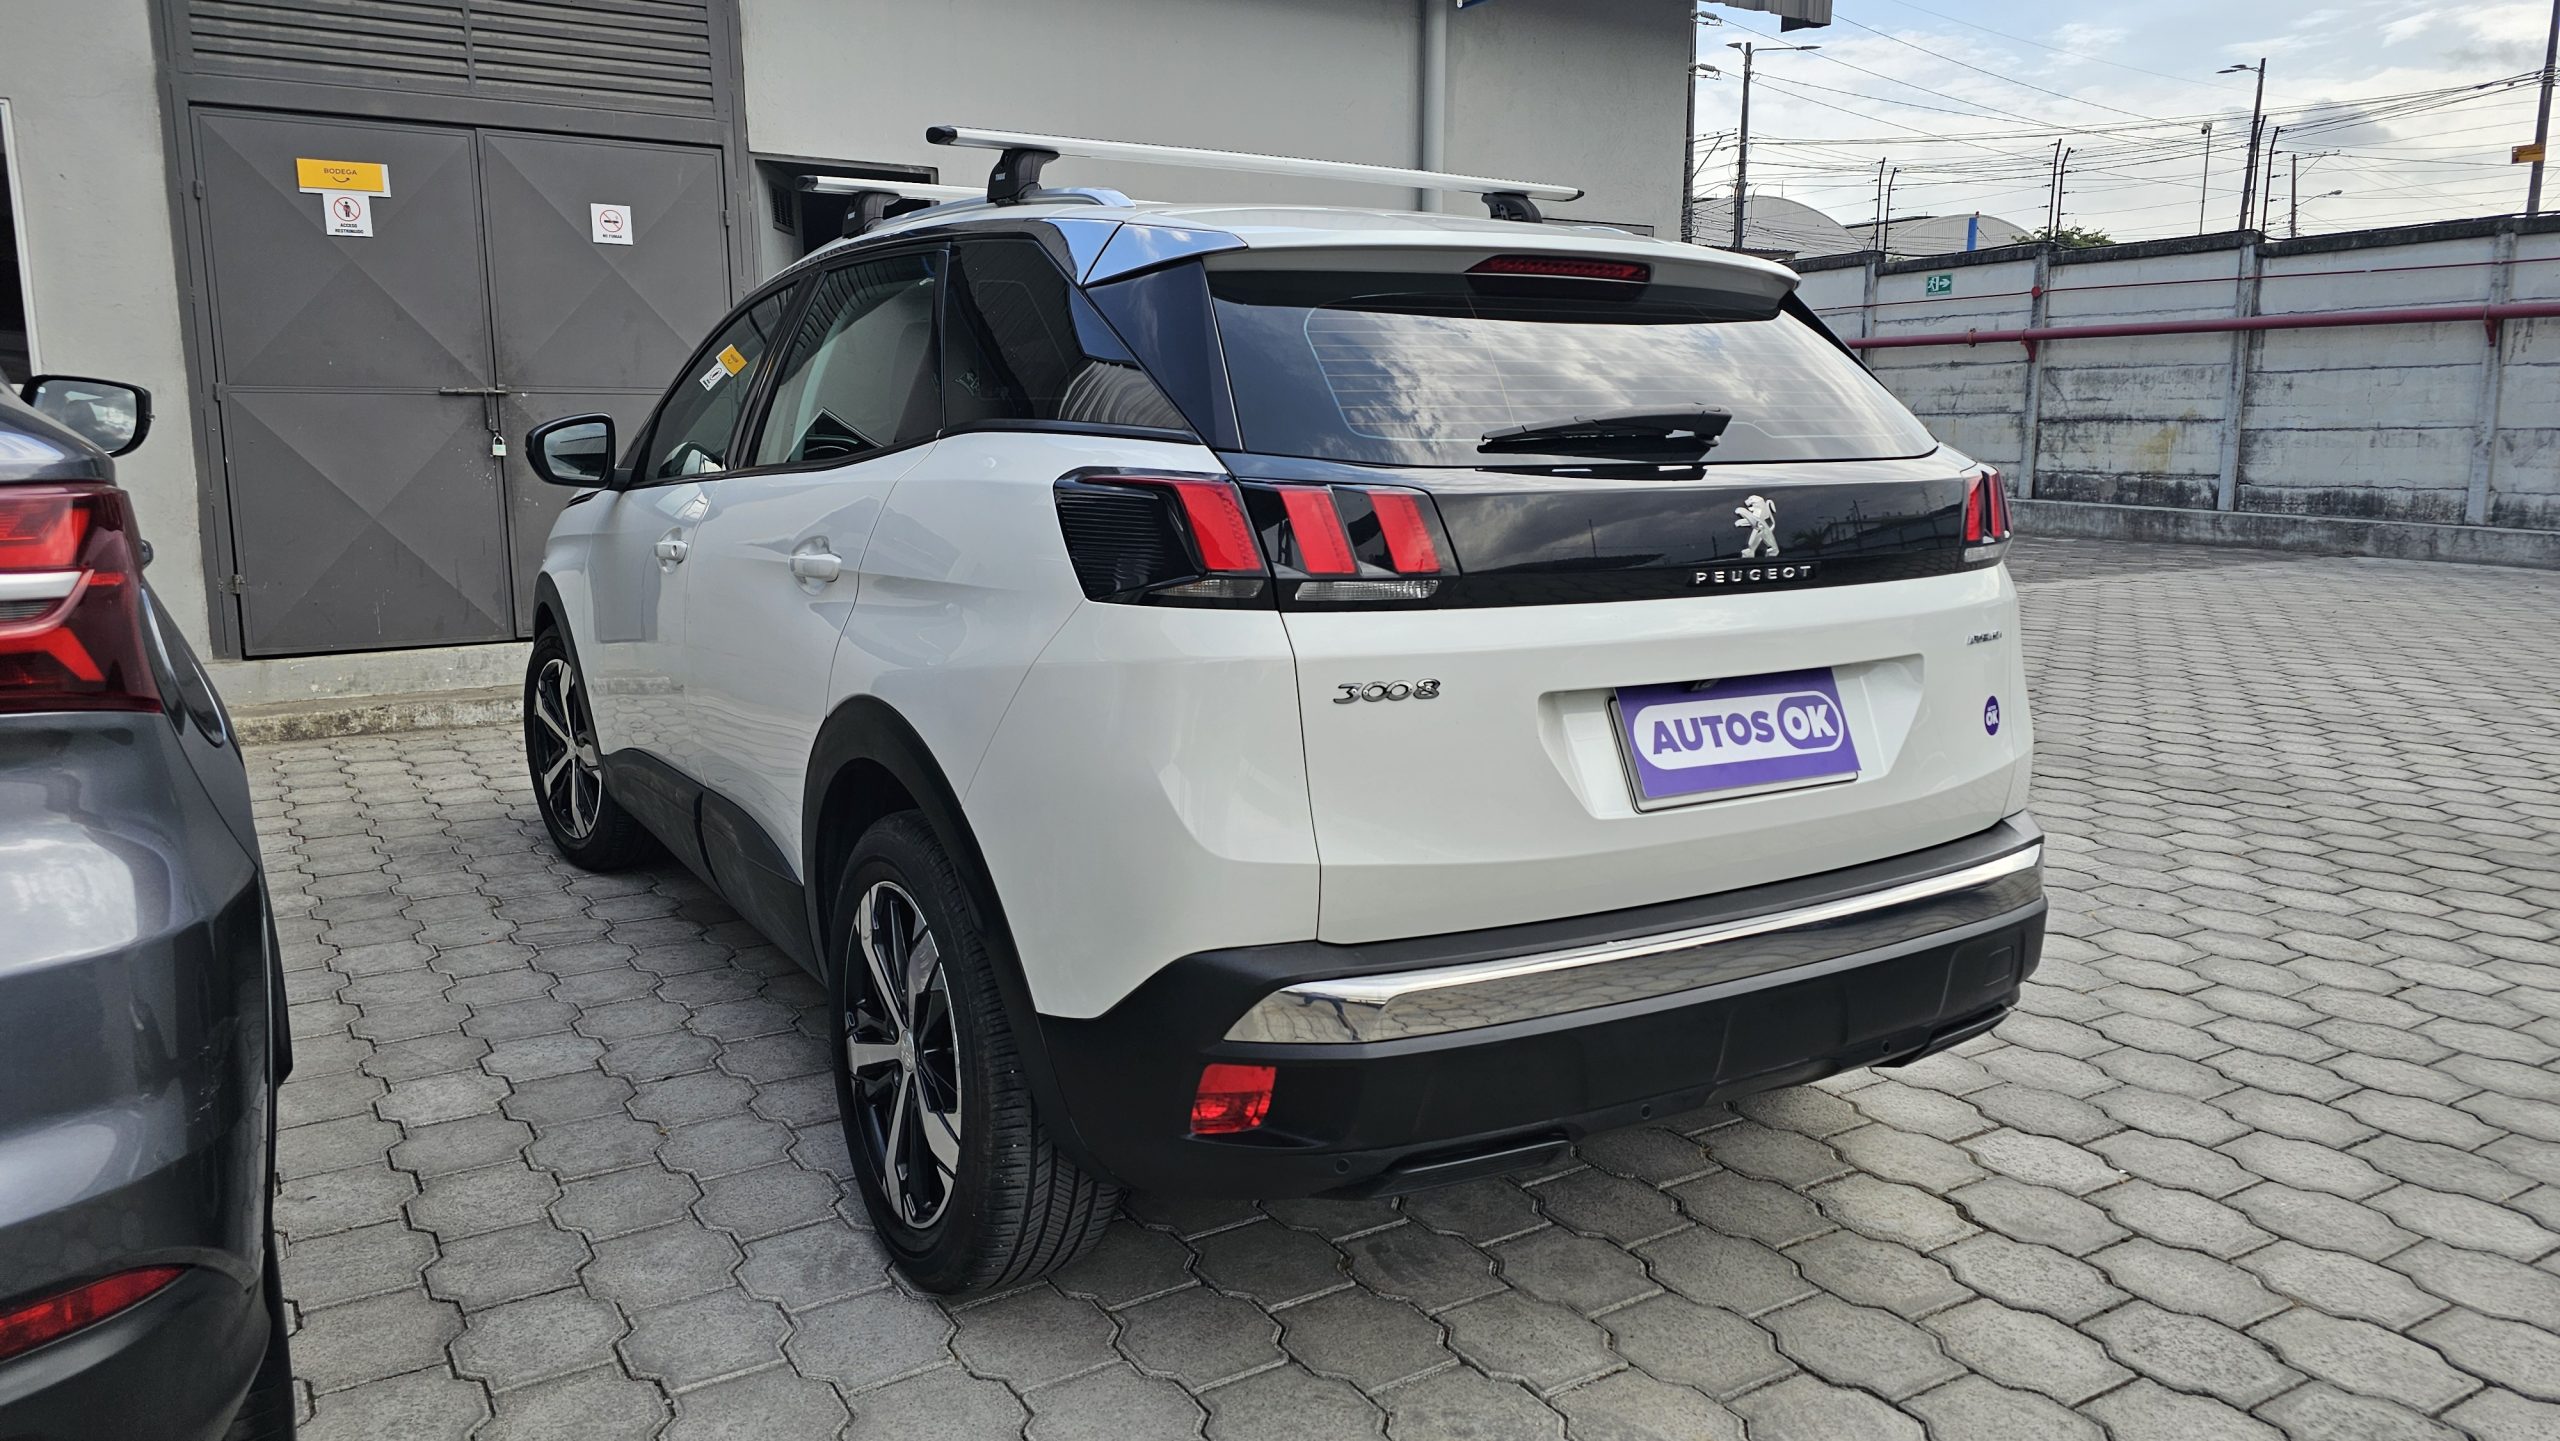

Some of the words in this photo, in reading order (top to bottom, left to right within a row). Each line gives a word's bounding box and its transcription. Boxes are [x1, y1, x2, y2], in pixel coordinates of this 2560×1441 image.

[1695, 565, 1811, 584] PEUGEOT
[1333, 679, 1441, 705] 3008
[1653, 711, 1776, 755] AUTOS
[1783, 704, 1837, 740] OK
